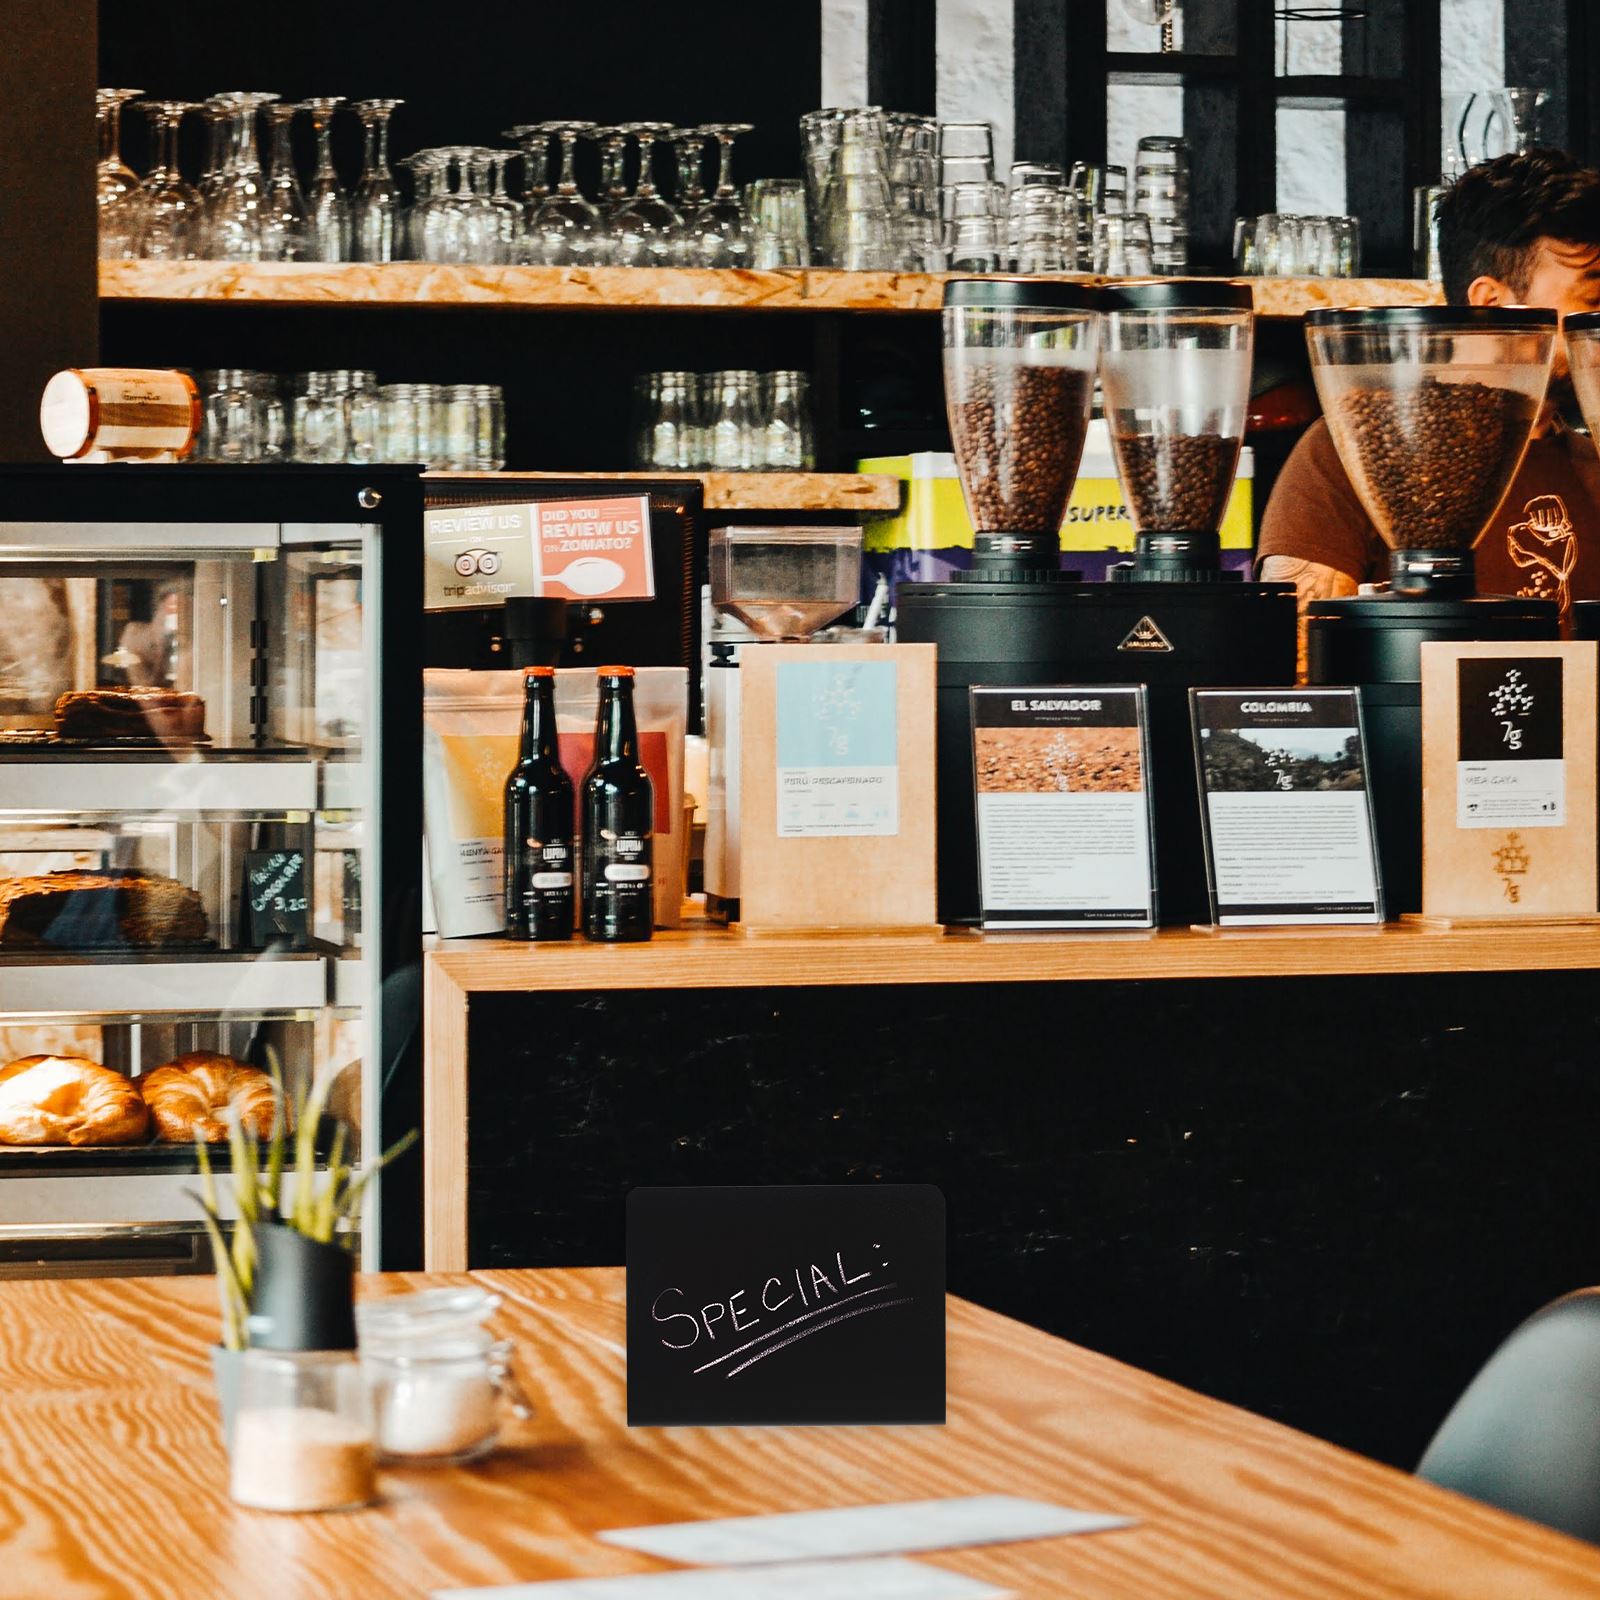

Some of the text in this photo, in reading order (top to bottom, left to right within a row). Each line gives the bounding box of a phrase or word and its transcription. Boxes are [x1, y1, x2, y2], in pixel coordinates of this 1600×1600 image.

[542, 508, 600, 521] DID YOU
[1068, 505, 1130, 523] SUPER
[430, 514, 522, 533] REVIEW US
[542, 520, 640, 538] REVIEW US
[1010, 699, 1102, 712] EL SALVADOR
[1240, 702, 1313, 713] COLOMBIA
[1500, 721, 1523, 750] 7g
[1273, 769, 1294, 790] 7g
